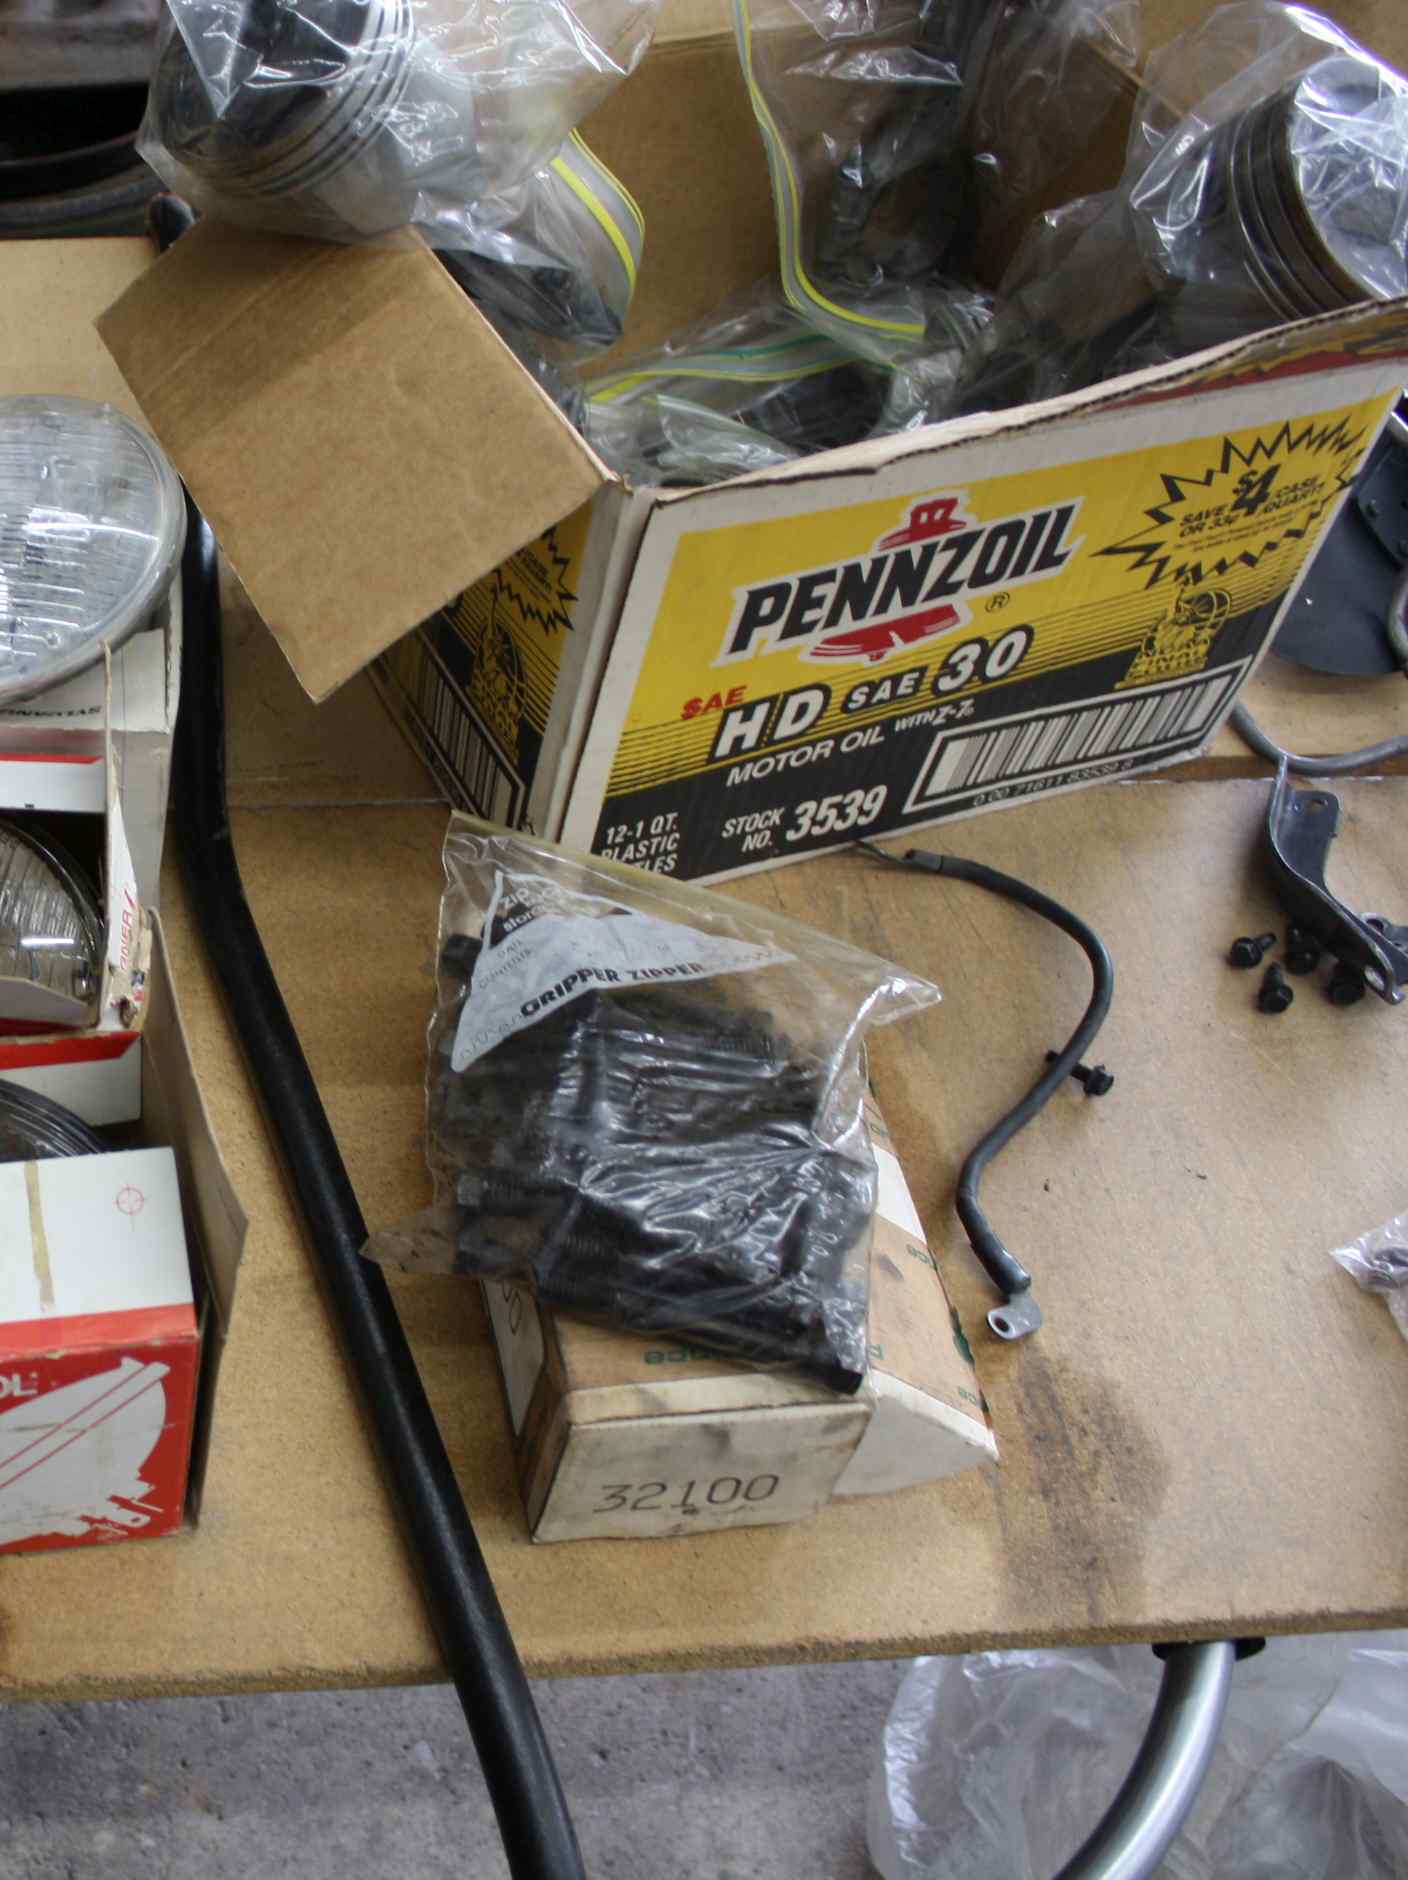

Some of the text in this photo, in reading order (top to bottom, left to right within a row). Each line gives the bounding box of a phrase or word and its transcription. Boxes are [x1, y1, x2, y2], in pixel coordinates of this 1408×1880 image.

[726, 503, 1076, 655] PENNZOIL
[681, 685, 747, 721] SAE
[713, 629, 1028, 759] HD SAE 30
[726, 738, 833, 788] MOTOR
[840, 726, 886, 752] OIL
[606, 812, 679, 844] 12-1 QT.
[721, 807, 785, 839] STOCK
[785, 784, 889, 841] 3539
[741, 831, 773, 852] NO.
[593, 1474, 779, 1514] 32100
